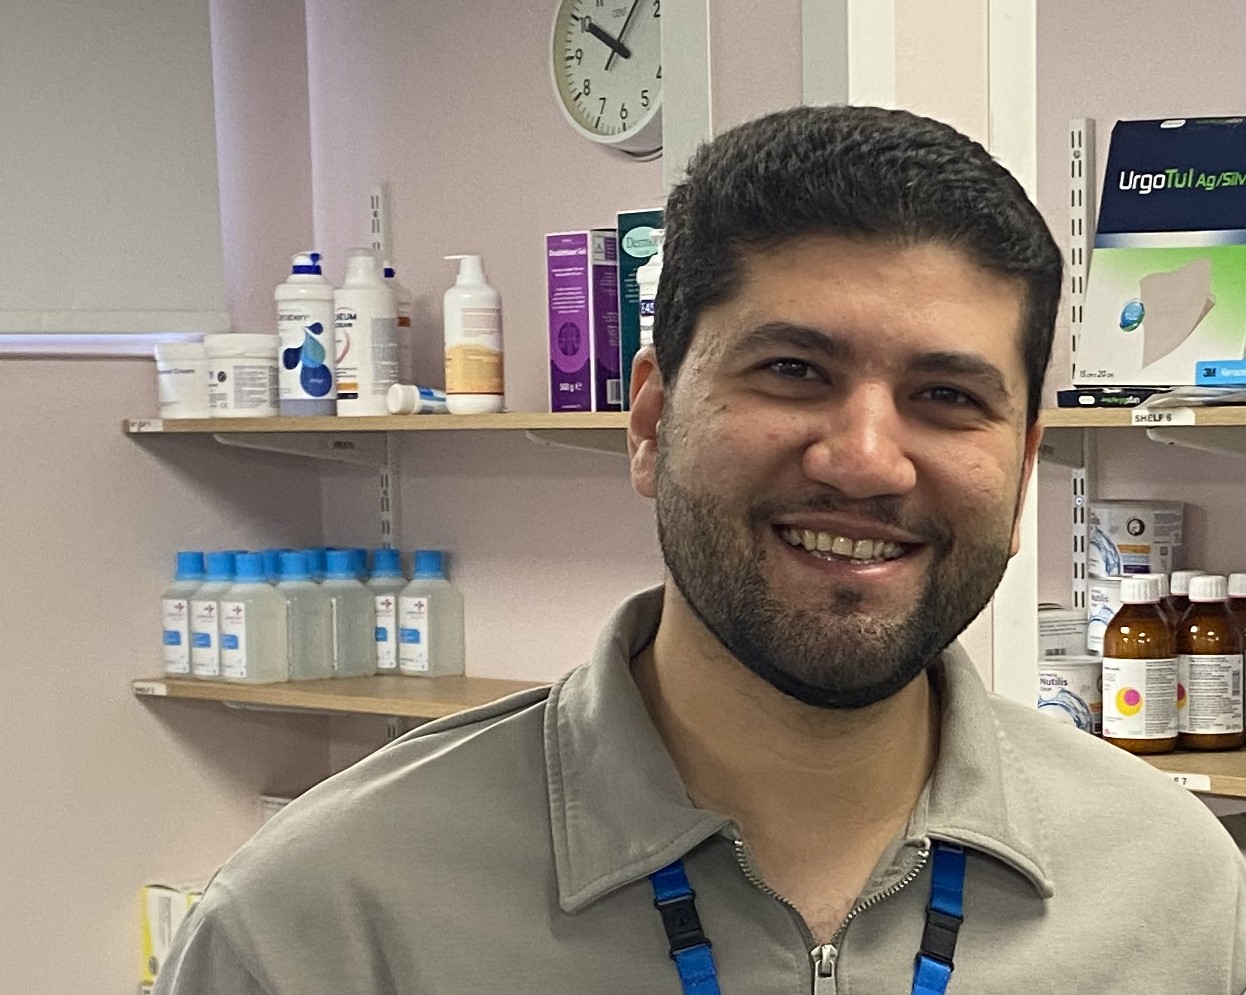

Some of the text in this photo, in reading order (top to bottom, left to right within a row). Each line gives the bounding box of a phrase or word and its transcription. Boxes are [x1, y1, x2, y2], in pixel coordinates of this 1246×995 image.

[575, 49, 583, 65] 9
[583, 79, 590, 96] 8
[599, 97, 606, 114] 7
[641, 90, 650, 107] 5
[620, 103, 628, 120] 6
[1119, 168, 1194, 194] UrgoTul
[1135, 414, 1164, 422] SHELF
[1039, 677, 1068, 687] Nutilis
